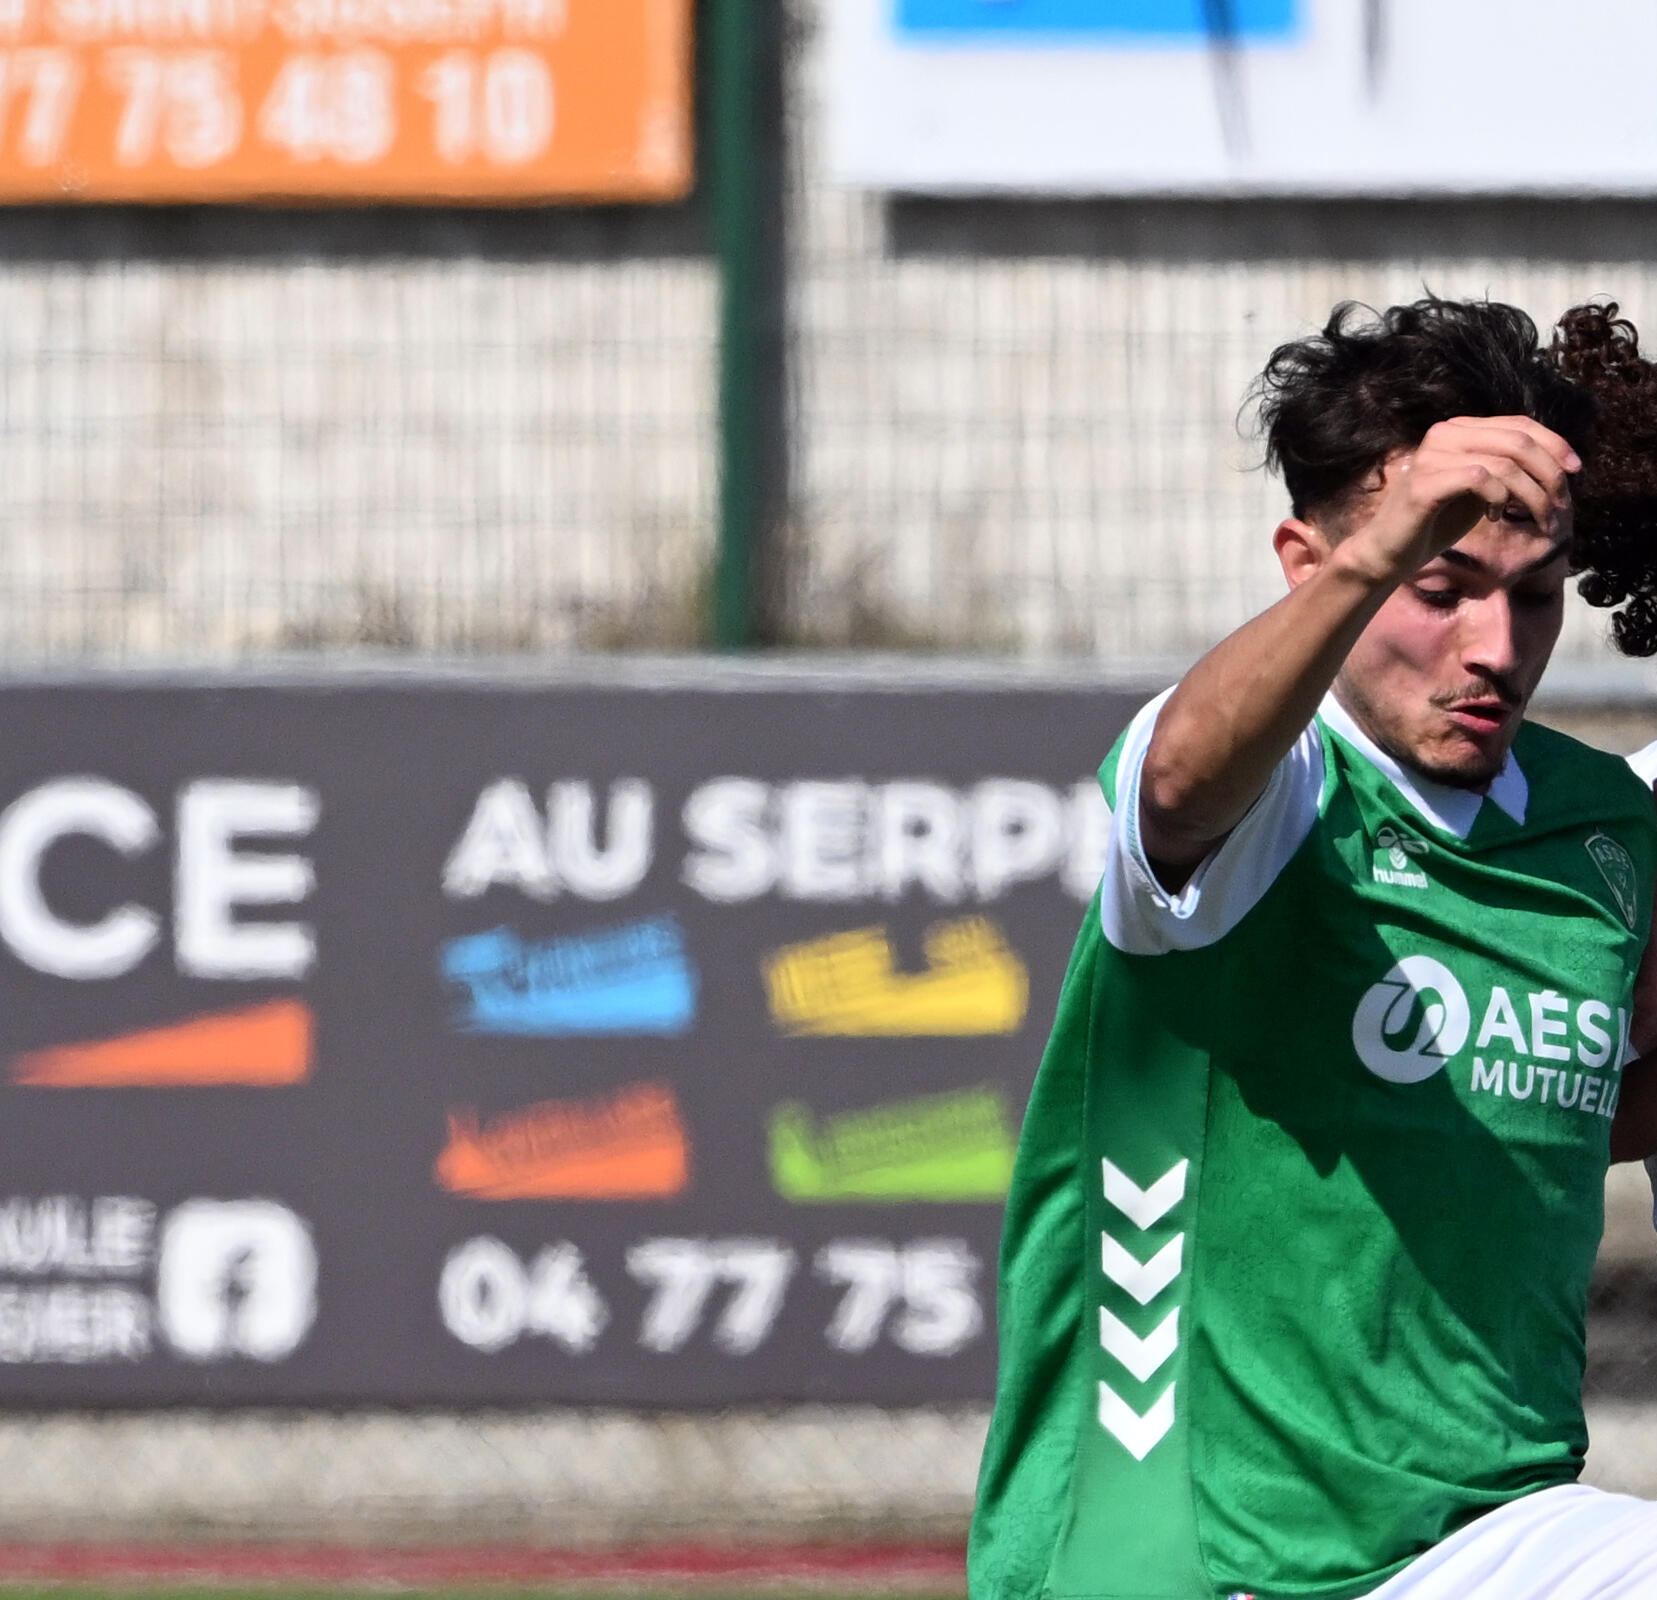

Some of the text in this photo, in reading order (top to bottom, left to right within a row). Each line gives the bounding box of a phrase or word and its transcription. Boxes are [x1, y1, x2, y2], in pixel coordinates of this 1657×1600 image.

[0, 50, 82, 165] 7
[106, 50, 242, 167] 75
[420, 48, 553, 164] 10
[0, 775, 320, 980] CE
[442, 777, 654, 899] AU
[1373, 866, 1429, 889] hummel
[1470, 1056, 1619, 1120] MUTUELL
[1475, 985, 1632, 1073] AÉSI
[439, 1235, 984, 1357] 04 77 75
